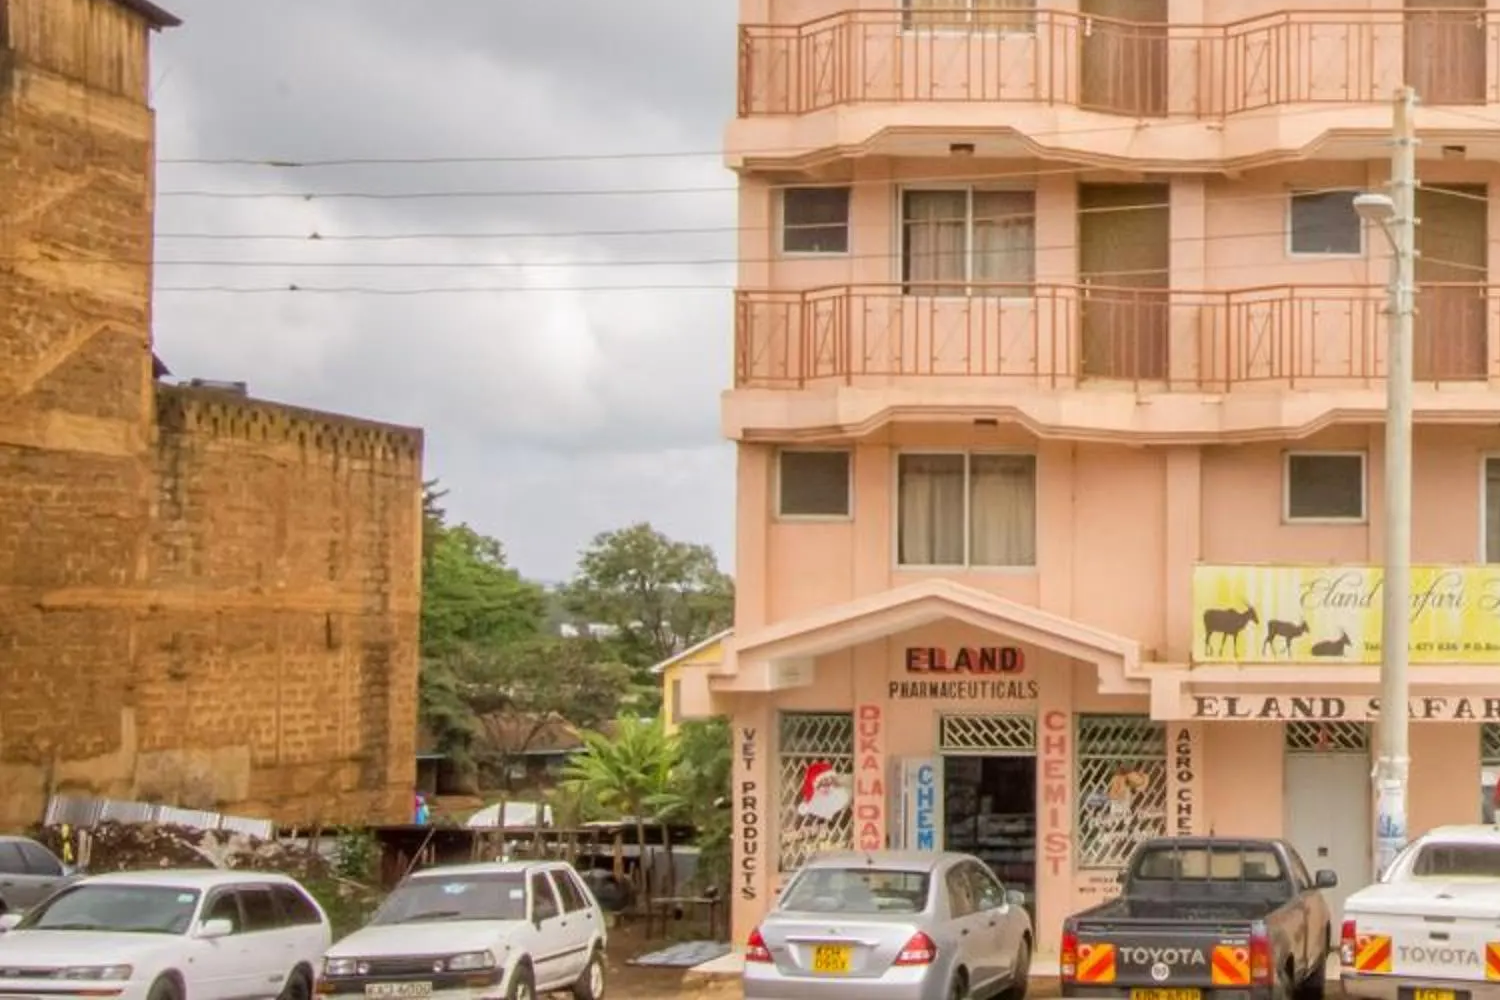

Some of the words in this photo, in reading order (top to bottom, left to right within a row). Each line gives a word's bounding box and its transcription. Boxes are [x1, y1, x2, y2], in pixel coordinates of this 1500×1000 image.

[1300, 573, 1384, 611] Eland
[1410, 572, 1468, 624] afari
[906, 647, 1024, 675] ELAND
[888, 680, 1040, 699] PHARMACEUTICALS
[1192, 696, 1346, 718] ELAND
[742, 728, 756, 771] VET
[859, 705, 881, 770] DUKA
[1176, 728, 1194, 783] AGRO
[1044, 711, 1068, 876] CHEMIST
[1177, 788, 1193, 837] CHE
[742, 781, 758, 900] PRODUCTS
[1119, 946, 1207, 965] TOYOTA
[1398, 945, 1480, 965] TOYOTA
